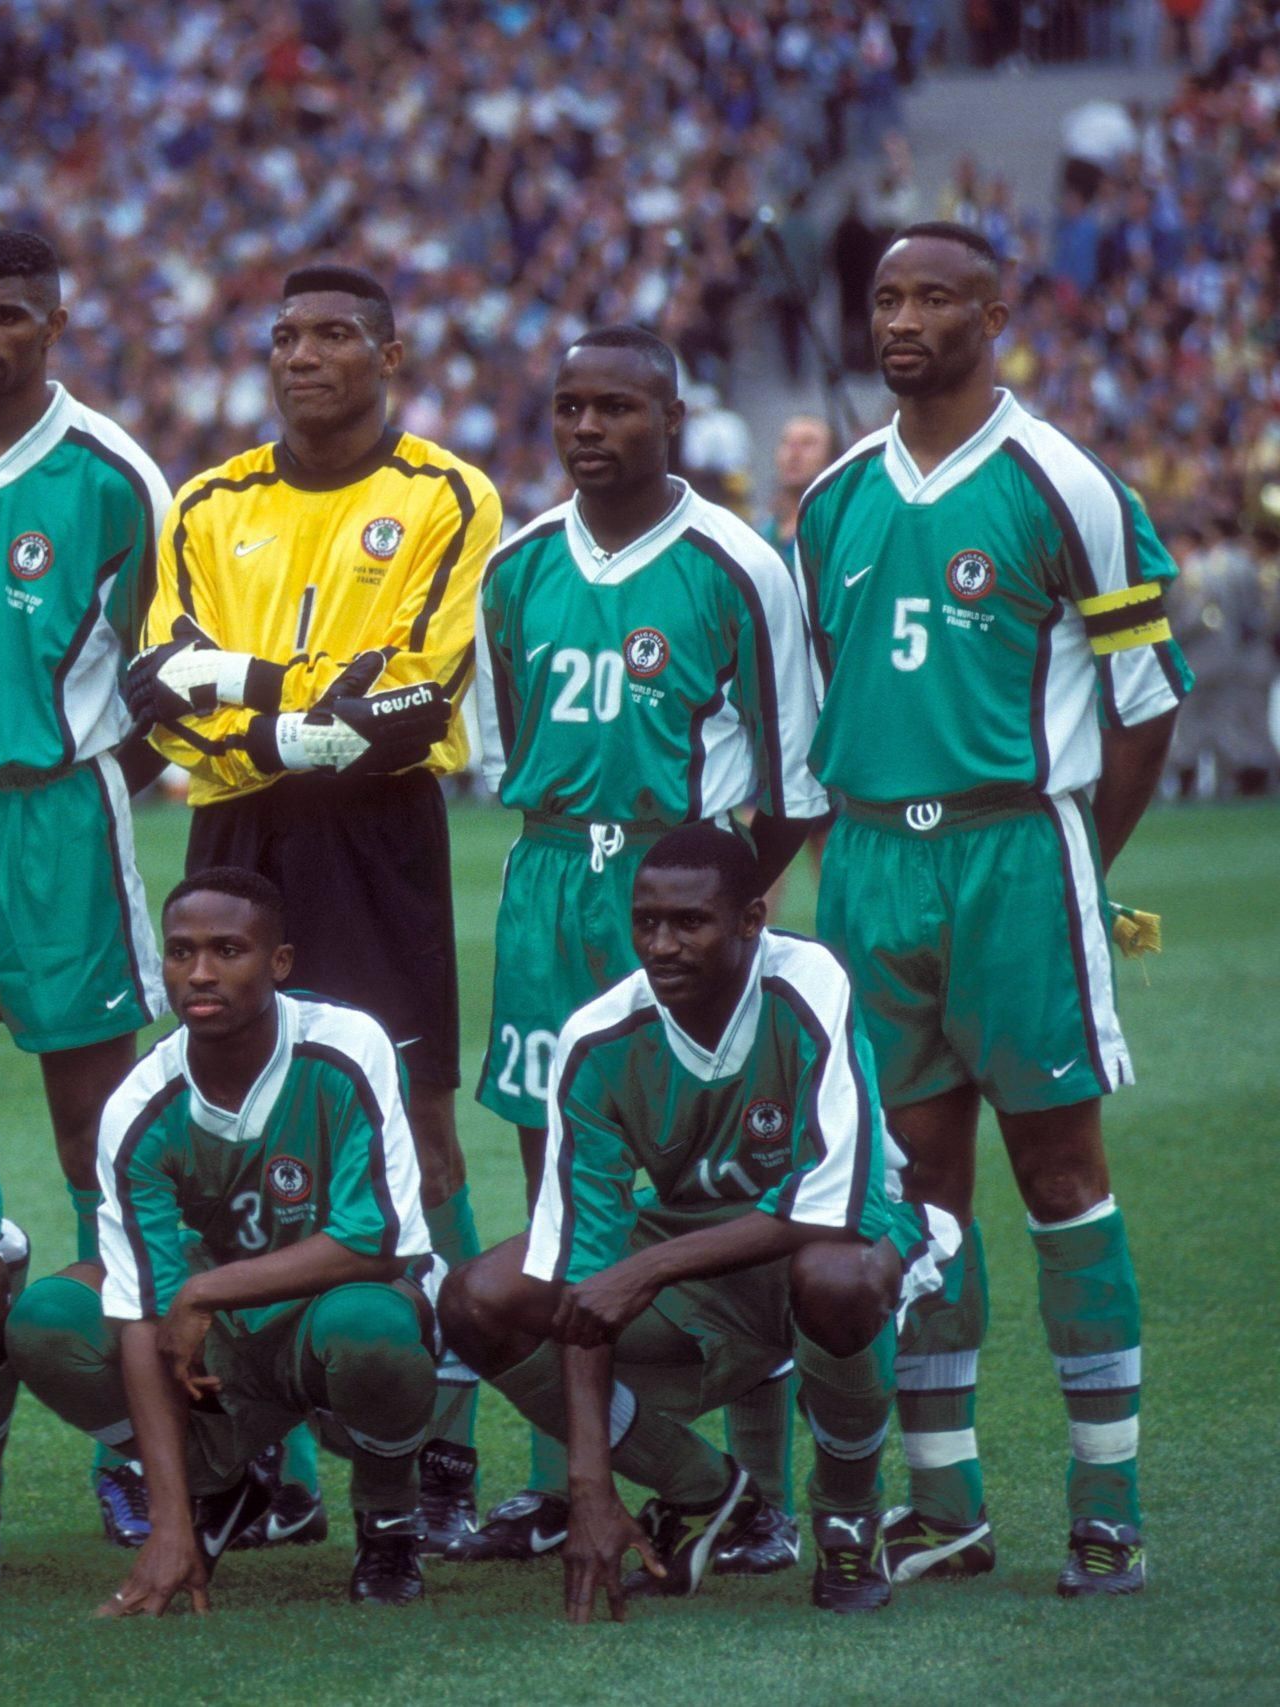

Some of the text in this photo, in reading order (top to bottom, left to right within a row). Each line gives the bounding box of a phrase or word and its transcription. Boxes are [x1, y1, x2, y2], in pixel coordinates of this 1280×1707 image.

[958, 552, 991, 570] NIGERIA
[294, 583, 317, 654] 1
[946, 615, 972, 630] FRANCE
[956, 608, 980, 621] WORLD
[980, 613, 995, 623] CUP
[633, 631, 664, 649] NIGERIA
[891, 597, 930, 672] 5
[550, 647, 625, 723] 20
[652, 689, 666, 700] CUP
[371, 686, 434, 717] reusch
[497, 1023, 559, 1101] 20
[231, 1190, 268, 1251] 3
